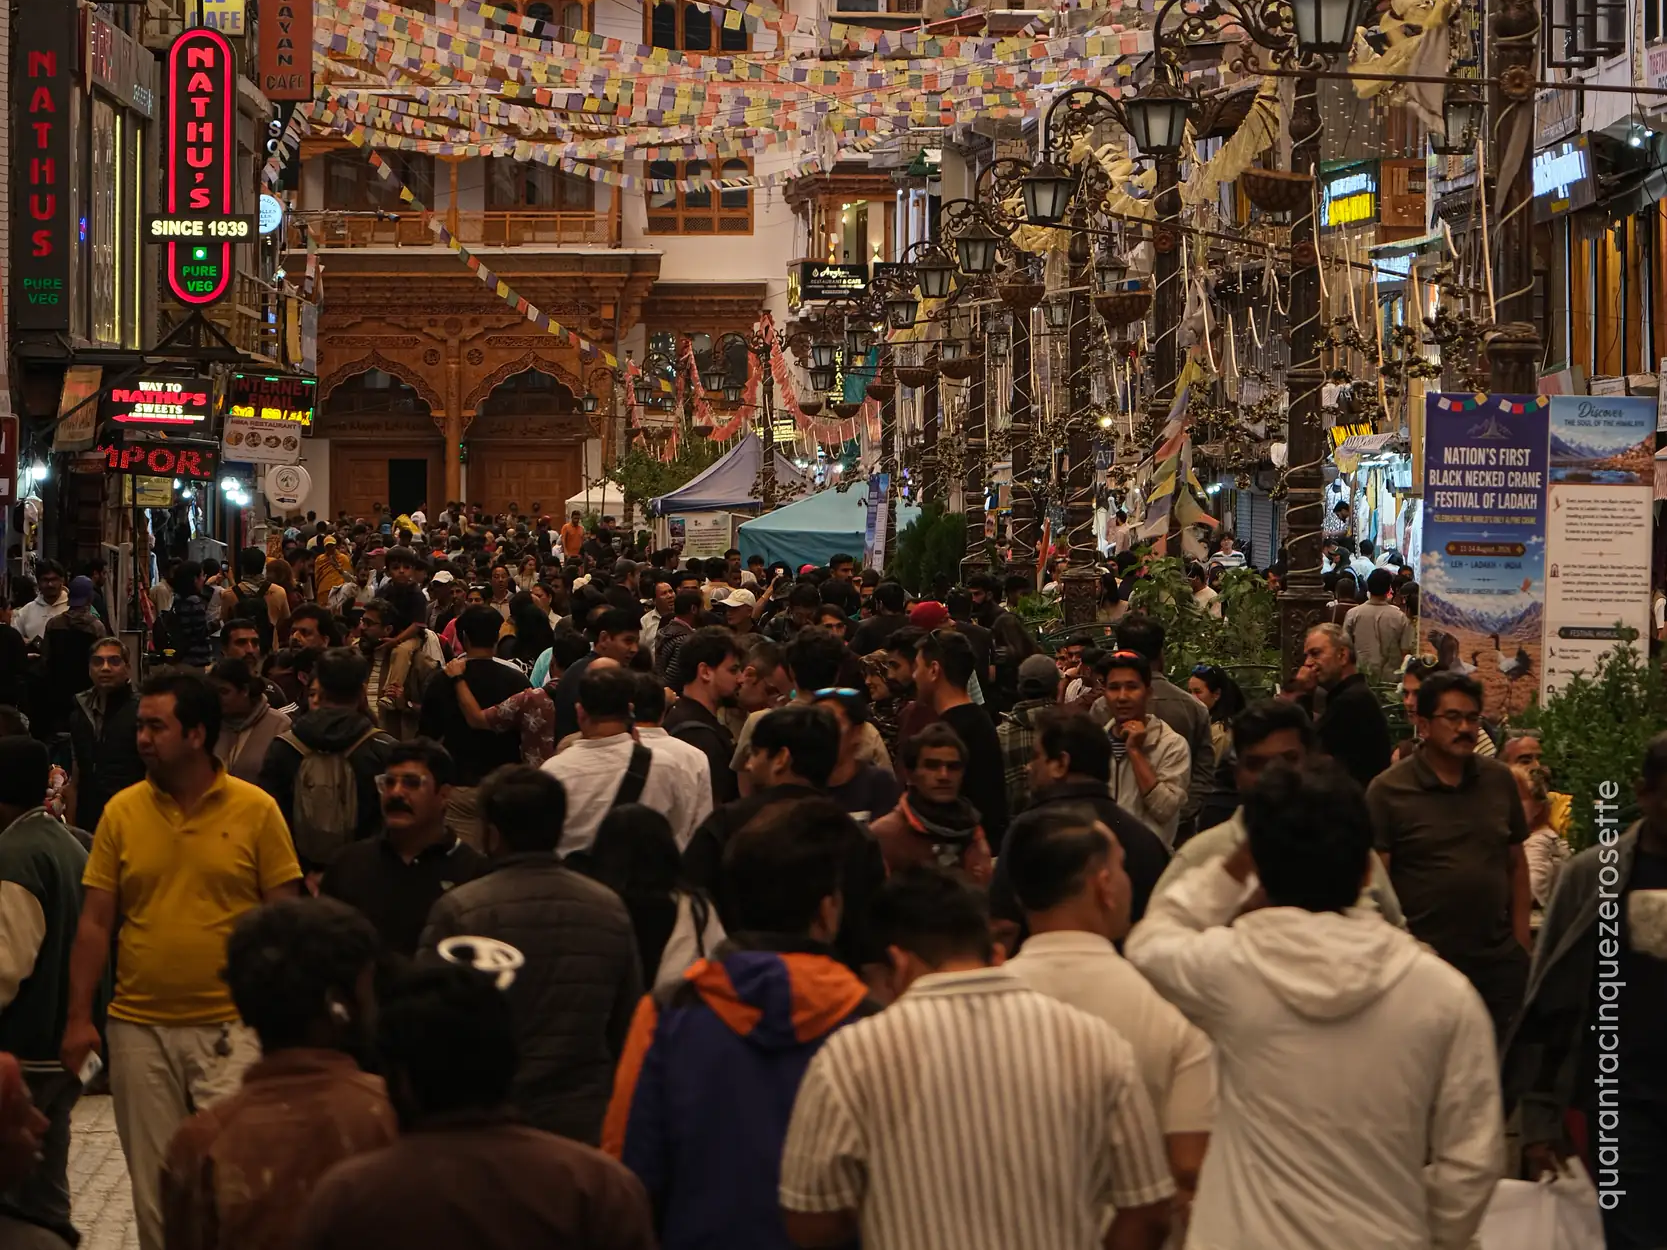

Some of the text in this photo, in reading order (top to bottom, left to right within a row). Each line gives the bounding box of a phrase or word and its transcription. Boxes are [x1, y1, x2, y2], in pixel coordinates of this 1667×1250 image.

[266, 74, 304, 91] CAFE
[186, 47, 215, 209] NATHU'S
[27, 50, 57, 257] NATHUS
[151, 220, 249, 237] SINCE 1939
[182, 265, 217, 278] PURE
[24, 278, 63, 290] PURE
[186, 281, 214, 292] VEG
[27, 293, 59, 305] VEG
[138, 381, 182, 393] WAY TO
[235, 377, 311, 397] INTERNET
[112, 389, 207, 406] NATHU'S
[248, 393, 293, 409] EMAIL
[134, 403, 183, 414] SWEETS
[1578, 401, 1624, 418] Discover
[250, 420, 297, 430] RESTAURANT
[1444, 447, 1531, 466] NATION'S FIRST
[1429, 469, 1542, 488] BLACK NECKED CRANE
[1434, 491, 1538, 509] FESTIVAL OF LADAKH
